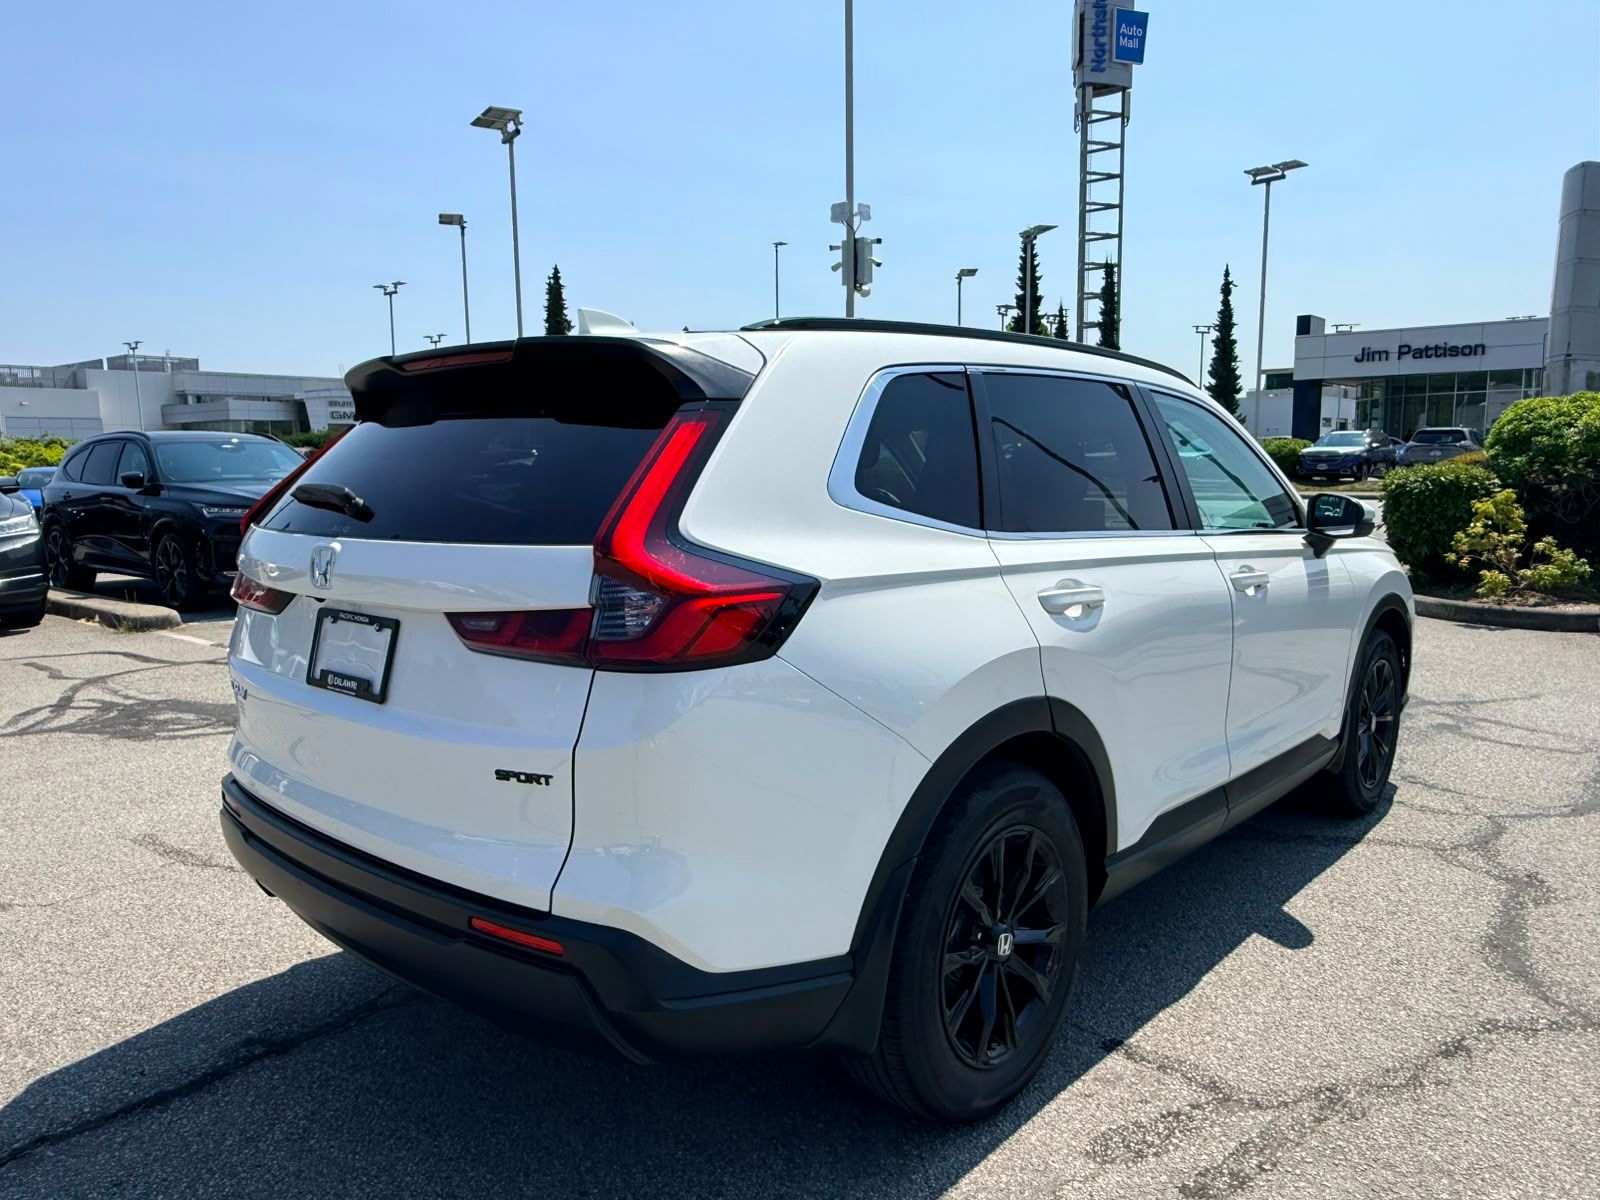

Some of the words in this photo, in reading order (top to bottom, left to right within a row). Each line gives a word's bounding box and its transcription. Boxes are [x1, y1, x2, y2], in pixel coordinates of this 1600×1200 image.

[1119, 24, 1143, 36] Auto
[1119, 36, 1139, 48] Mall
[1354, 346, 1389, 362] Jim
[1397, 342, 1486, 360] Pattison
[494, 768, 554, 786] SPORT
